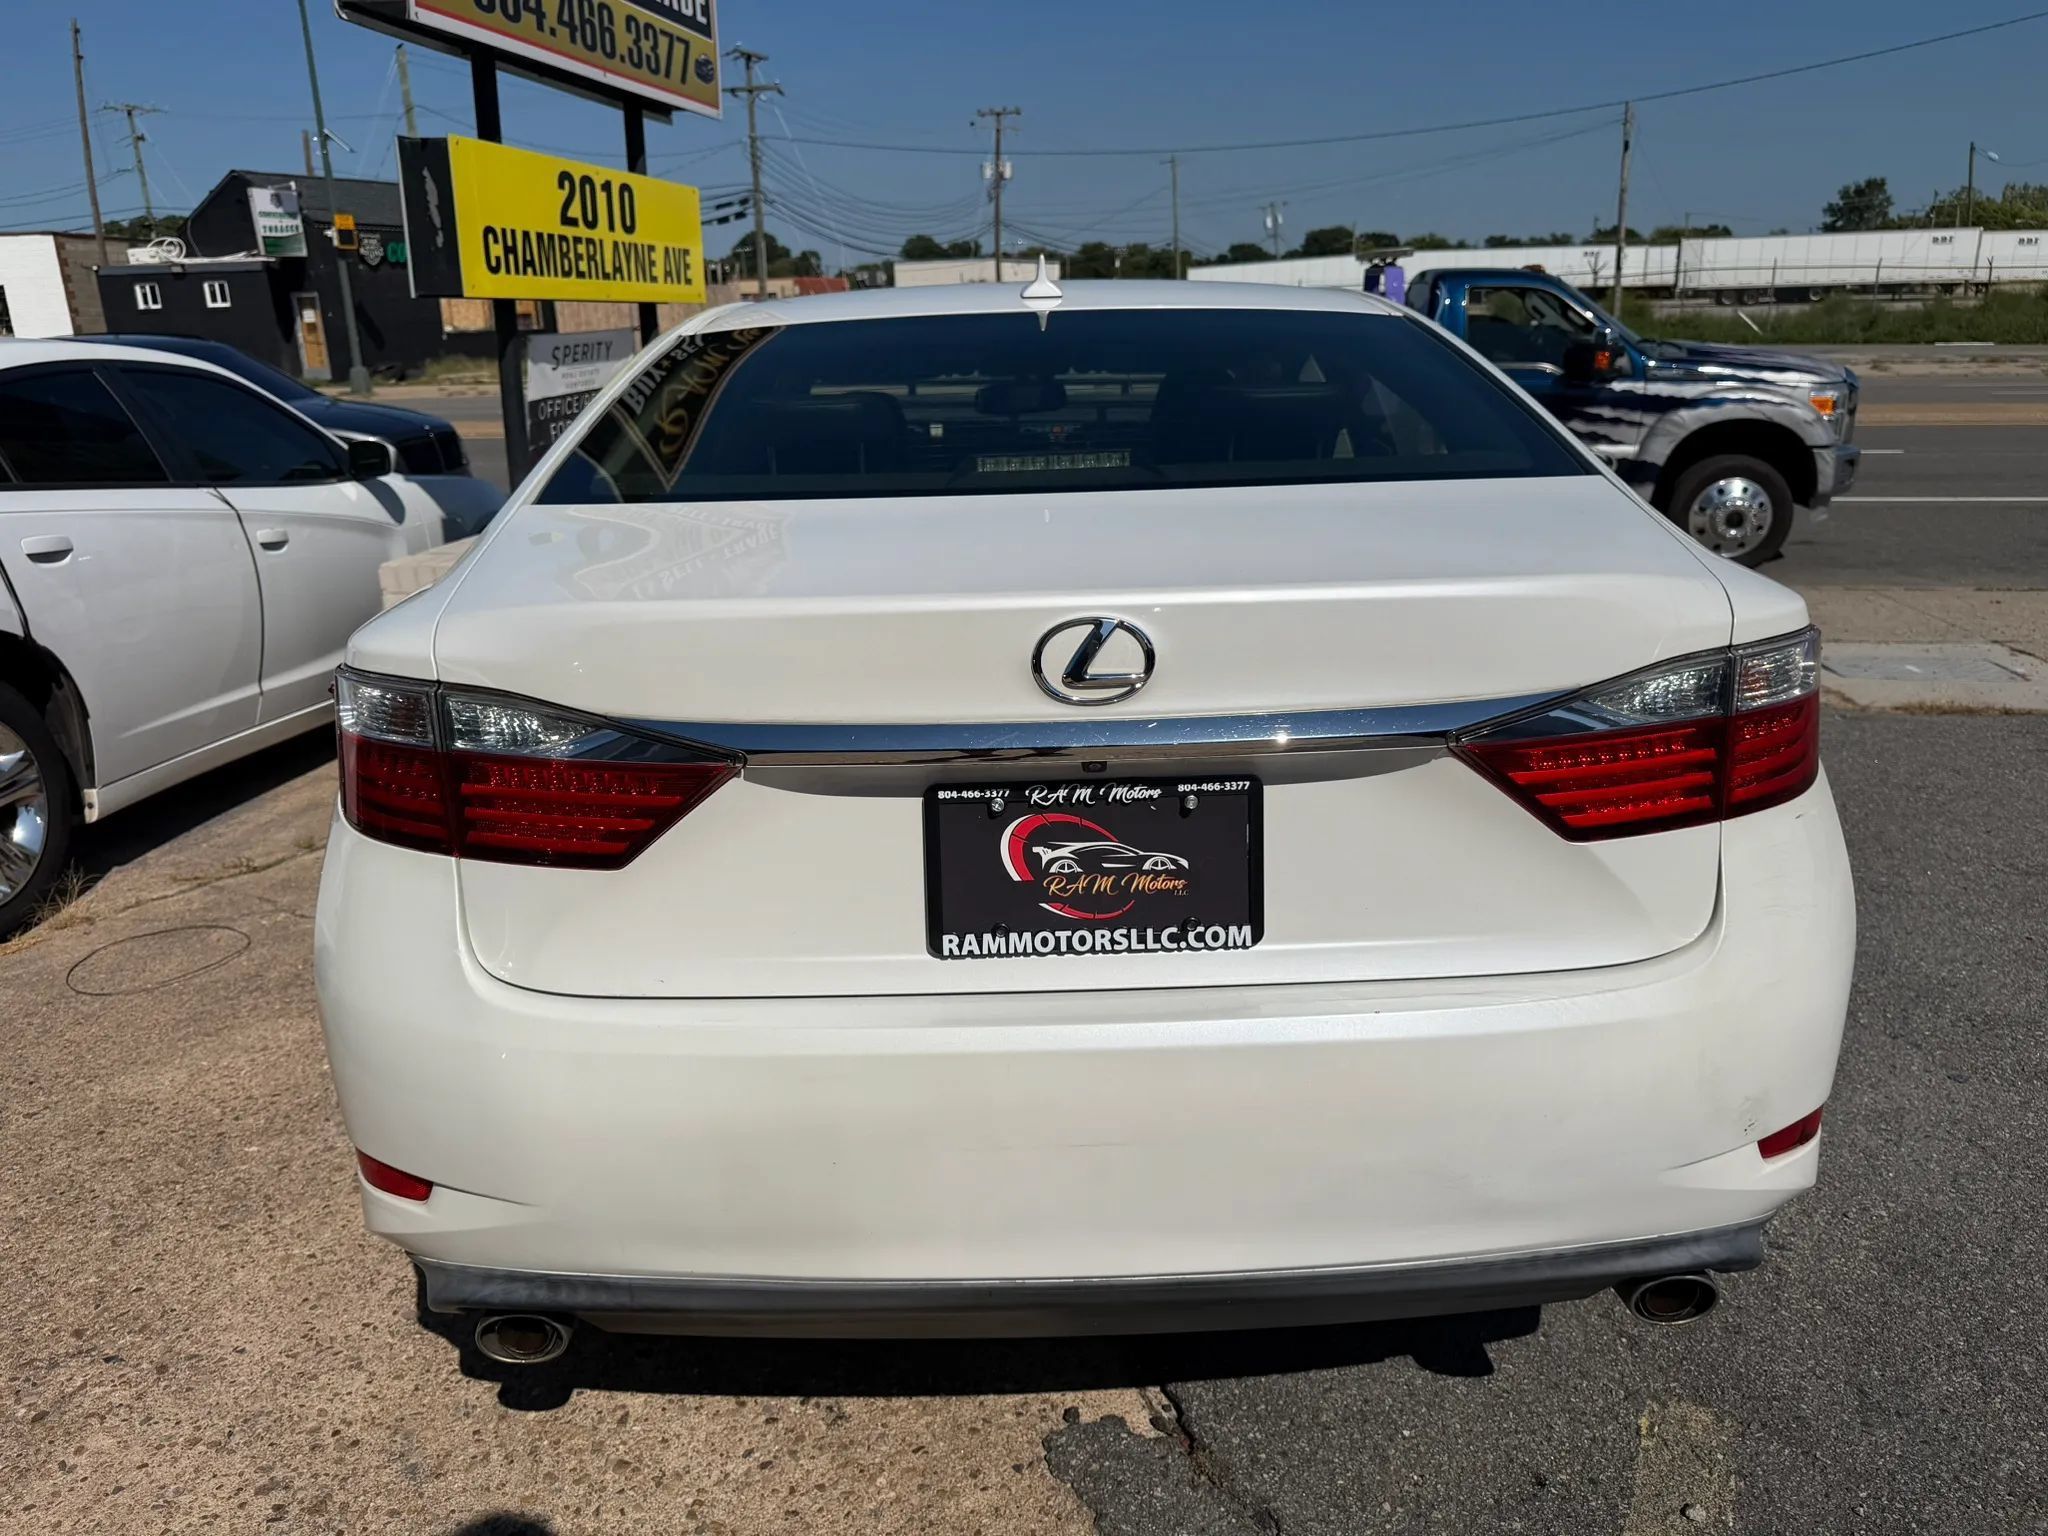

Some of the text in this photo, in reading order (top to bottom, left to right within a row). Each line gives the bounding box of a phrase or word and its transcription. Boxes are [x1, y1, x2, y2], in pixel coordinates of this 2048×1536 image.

[473, 0, 690, 85] 4.466.3377
[558, 170, 637, 235] 2010
[482, 225, 693, 285] CHAMBERLAYNE AVE
[551, 341, 613, 371] SPERITY
[937, 781, 1250, 806] 804-466-3377 RAM Motors 804-466-3377
[1043, 872, 1188, 897] RAM Motors
[942, 925, 1252, 957] RAMMOTORSLLC.COM
